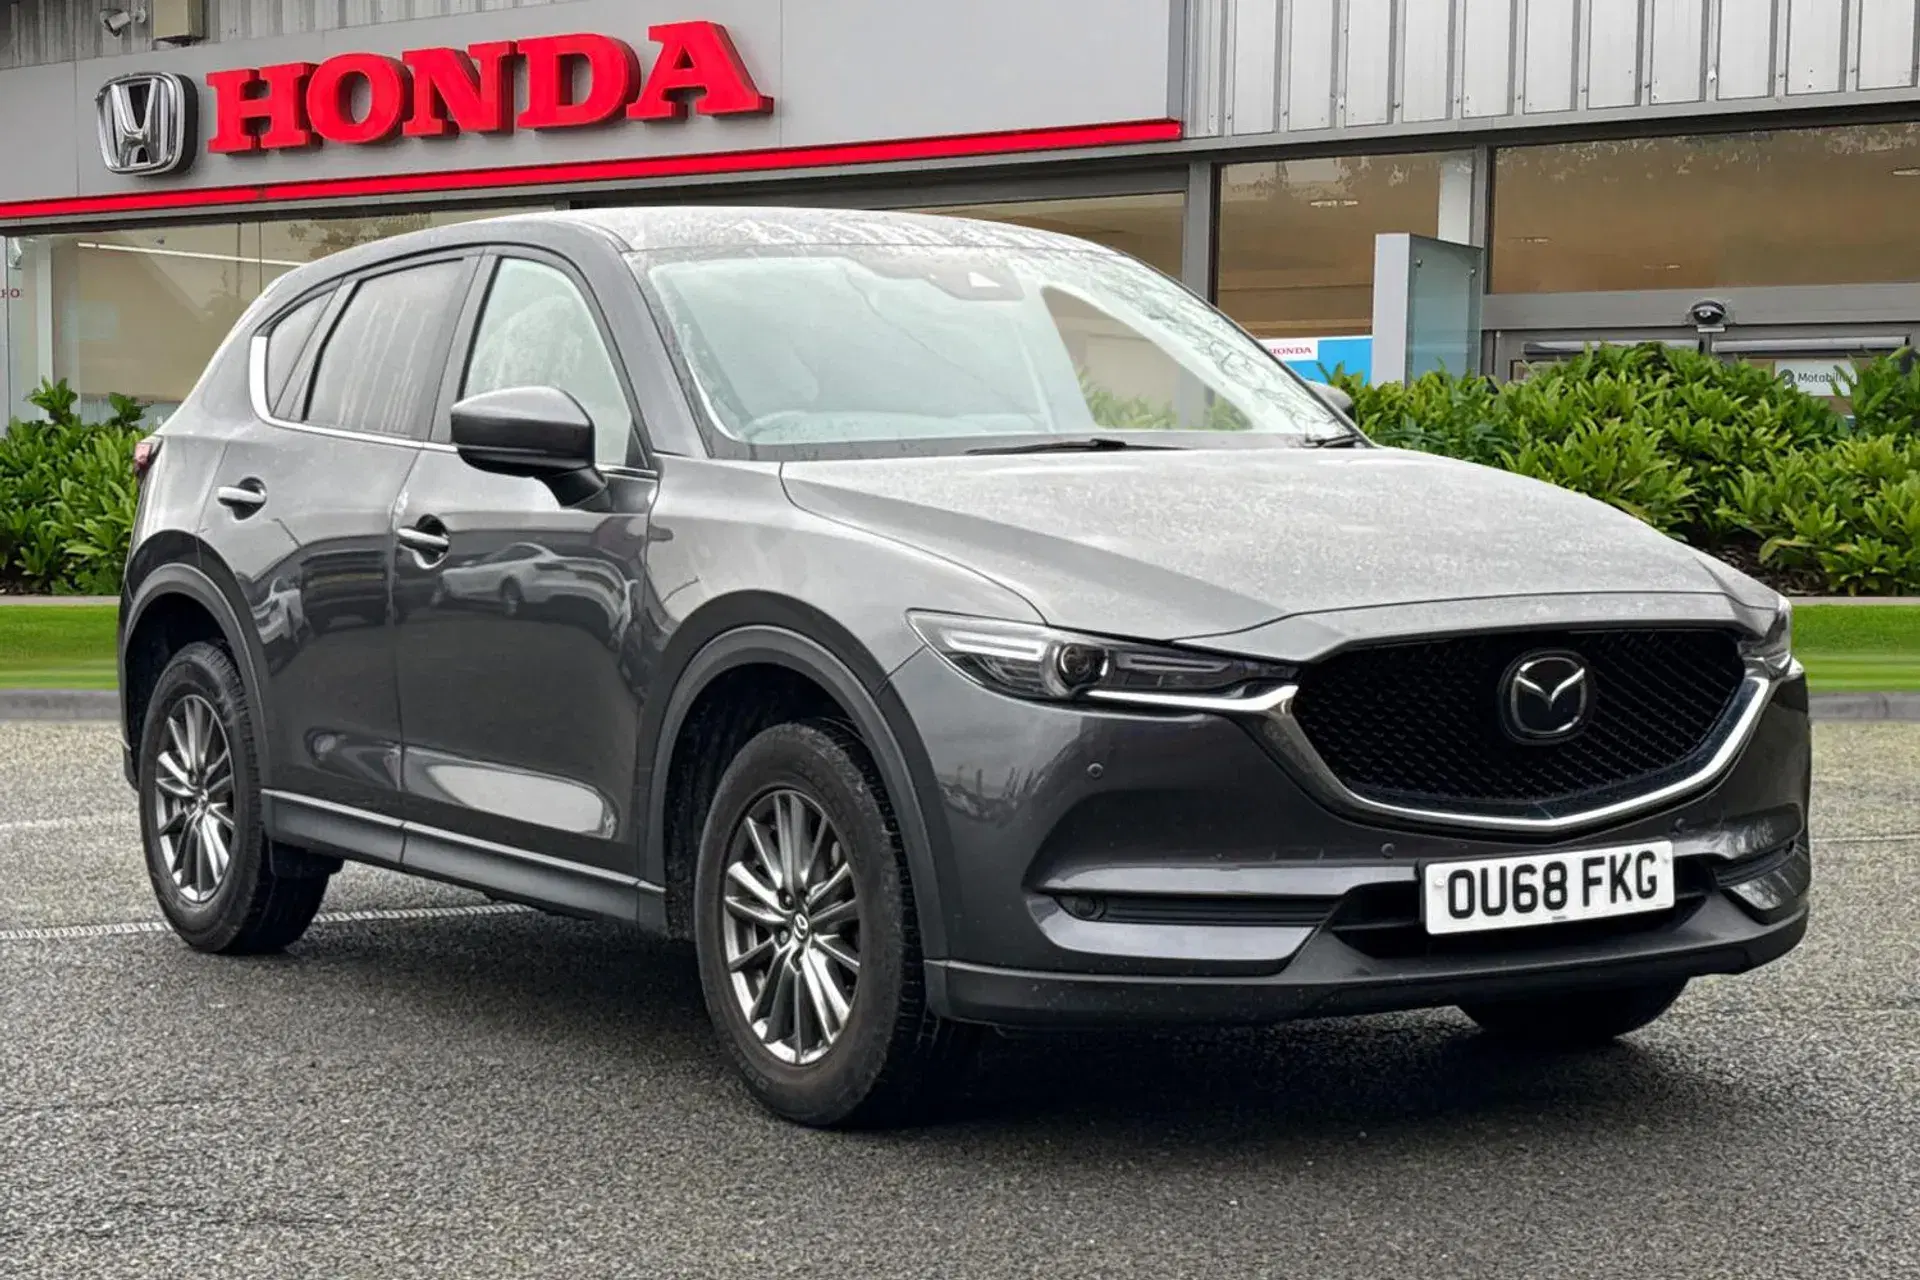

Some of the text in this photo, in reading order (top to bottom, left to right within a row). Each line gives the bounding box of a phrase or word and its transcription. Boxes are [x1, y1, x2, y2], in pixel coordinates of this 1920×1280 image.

[206, 21, 773, 154] HONDA
[1798, 371, 1854, 383] Motabili
[1448, 850, 1657, 919] OU68 FKG
